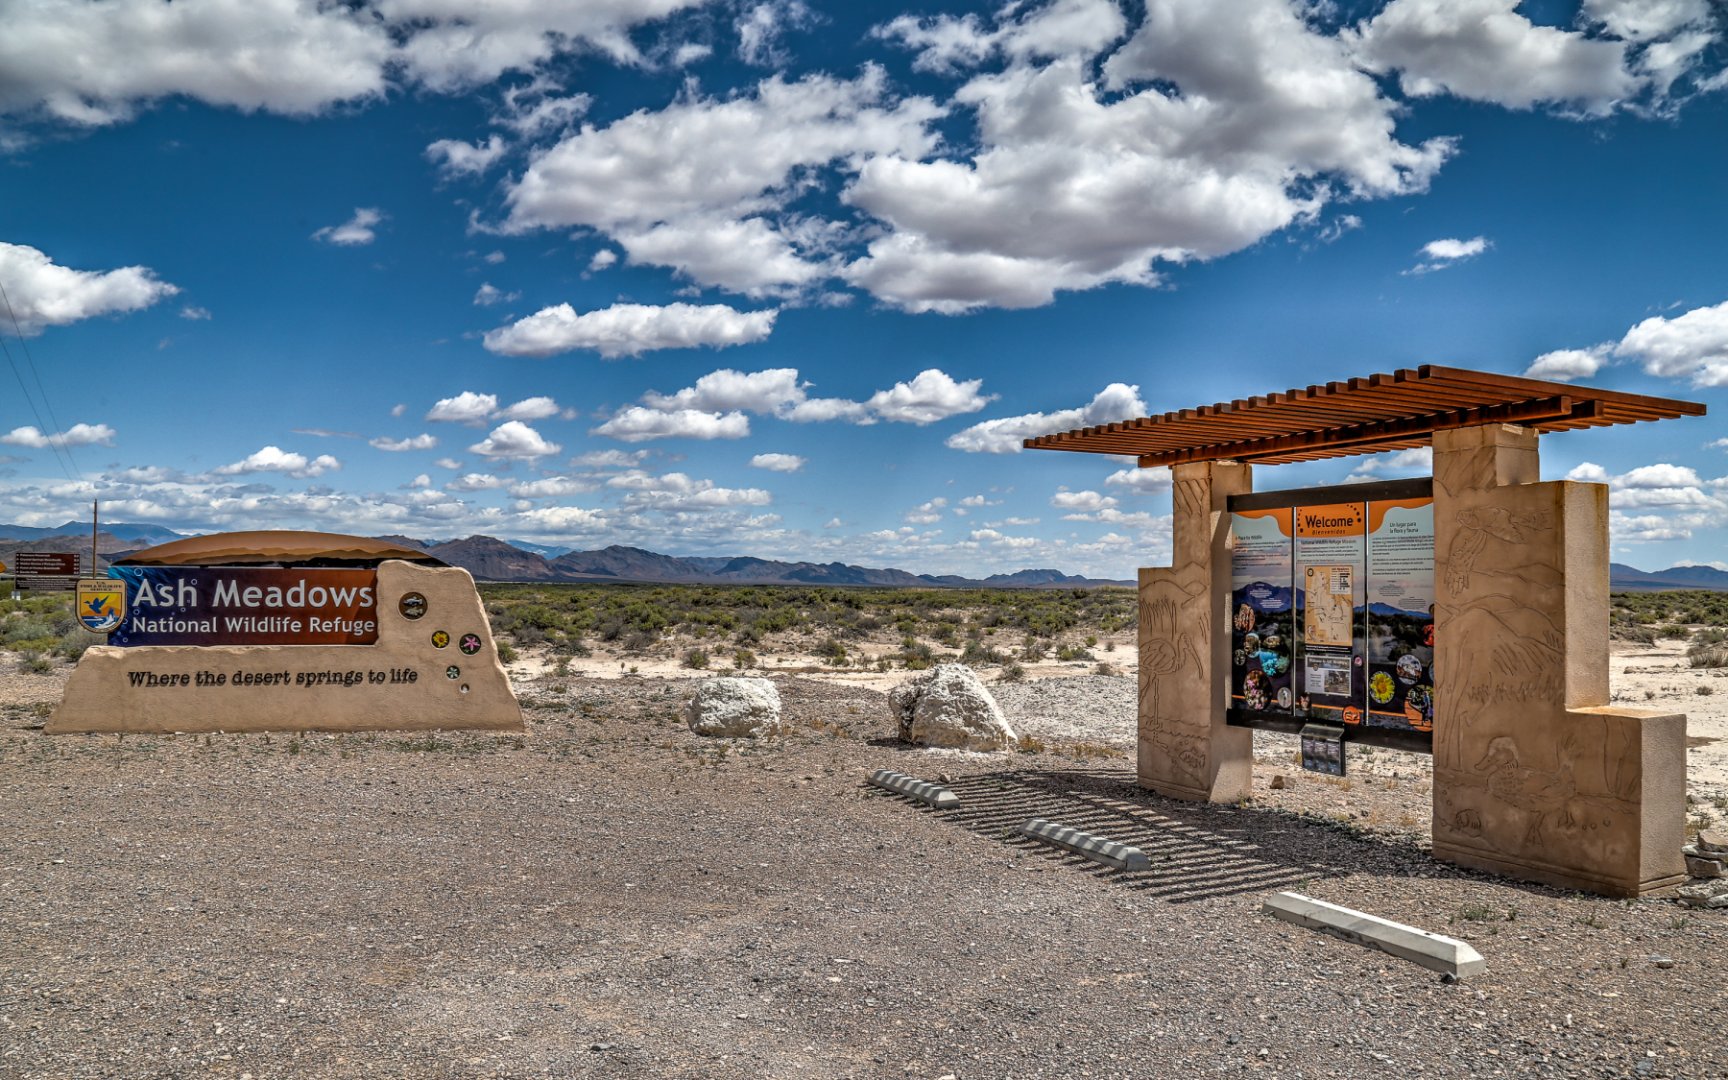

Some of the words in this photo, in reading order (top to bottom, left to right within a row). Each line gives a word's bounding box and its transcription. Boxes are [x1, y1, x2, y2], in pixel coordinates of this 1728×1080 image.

[1305, 515, 1353, 528] Welcome
[132, 578, 197, 607] Ash
[212, 578, 374, 608] Meadows
[132, 616, 218, 633] National
[224, 616, 302, 633] Wildlife
[309, 617, 375, 636] Refuge
[127, 671, 190, 687] Where
[195, 670, 227, 687] the
[231, 670, 291, 686] desert
[295, 670, 363, 688] springs
[367, 669, 386, 685] to
[389, 668, 418, 684] life
